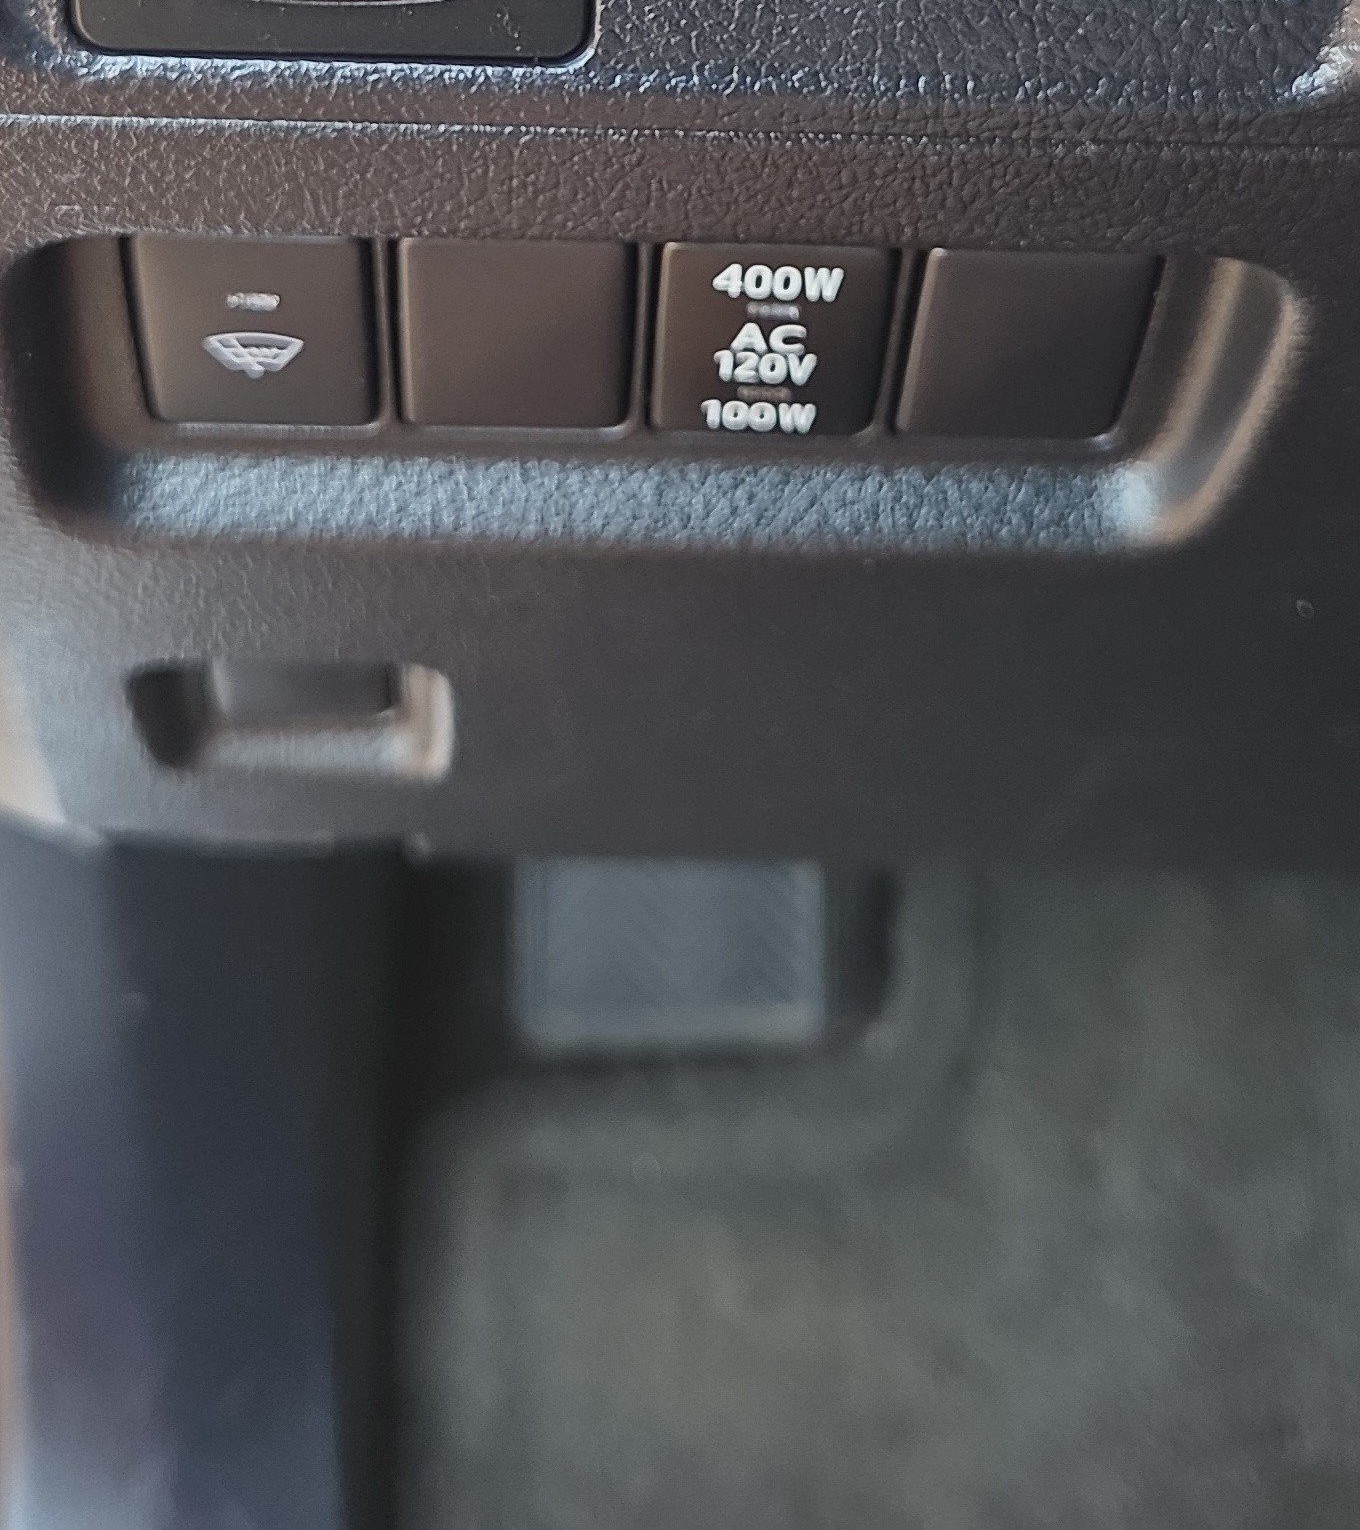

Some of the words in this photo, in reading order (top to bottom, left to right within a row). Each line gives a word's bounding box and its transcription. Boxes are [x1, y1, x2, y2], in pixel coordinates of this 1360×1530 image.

[712, 263, 844, 302] 400W
[730, 322, 807, 355] AC
[713, 349, 817, 386] 120V
[701, 399, 816, 434] 100W
